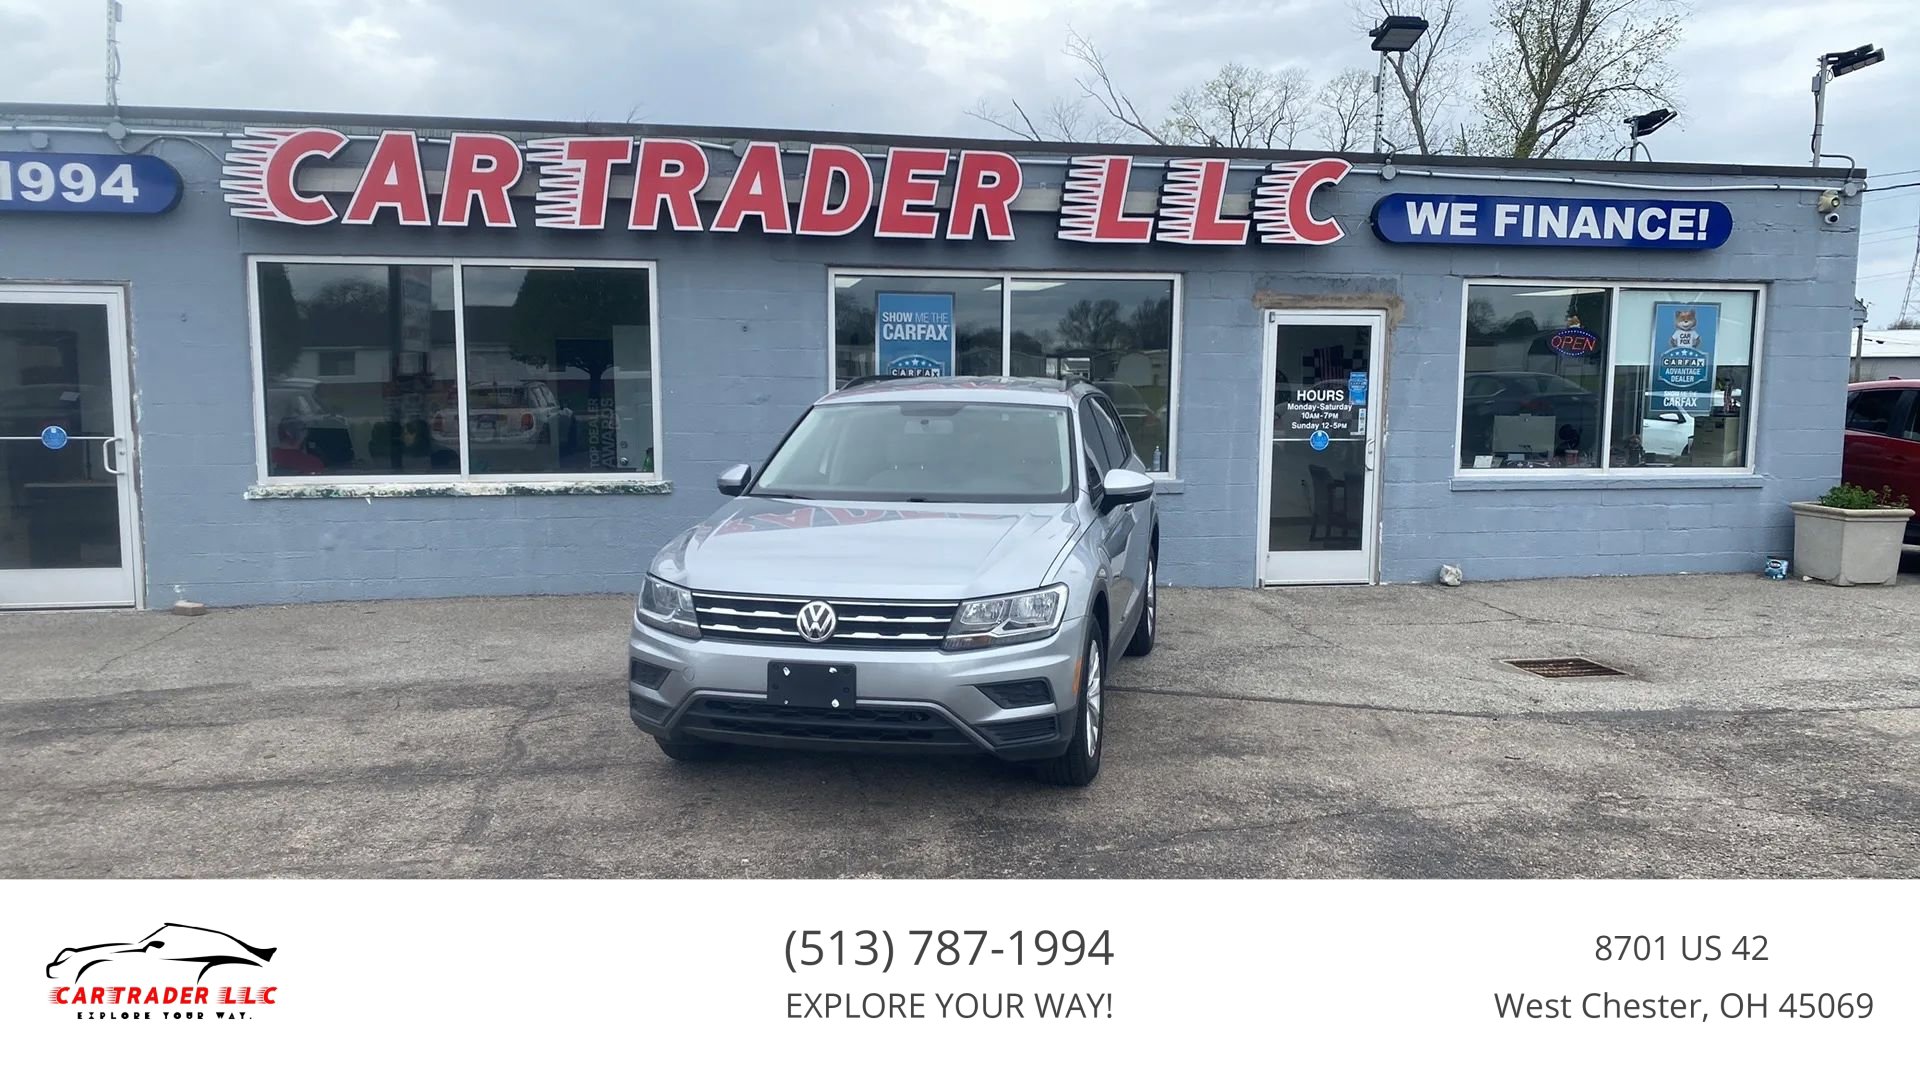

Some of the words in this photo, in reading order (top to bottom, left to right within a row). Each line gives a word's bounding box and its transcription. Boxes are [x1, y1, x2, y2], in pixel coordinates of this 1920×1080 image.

[0, 161, 139, 203] 1994
[1058, 155, 1353, 245] LLC
[1406, 201, 1478, 236] WE
[1494, 204, 1710, 241] FINANCE!
[882, 312, 913, 322] SHOW
[915, 312, 929, 323] ME
[931, 313, 949, 323] THE
[882, 323, 949, 341] CARFAX
[1551, 335, 1596, 351] OPEN
[1663, 359, 1705, 367] CARFAX
[891, 368, 940, 377] CARFAX
[1665, 367, 1701, 376] ADVANTAGE
[1297, 390, 1345, 401] HOURS
[1663, 397, 1697, 407] CARFAX
[1287, 403, 1353, 412] Monday-Saturday
[588, 398, 600, 444] DEALER
[1291, 422, 1320, 430] Sunday
[601, 397, 616, 468] AWARDS
[589, 447, 600, 468] TOP
